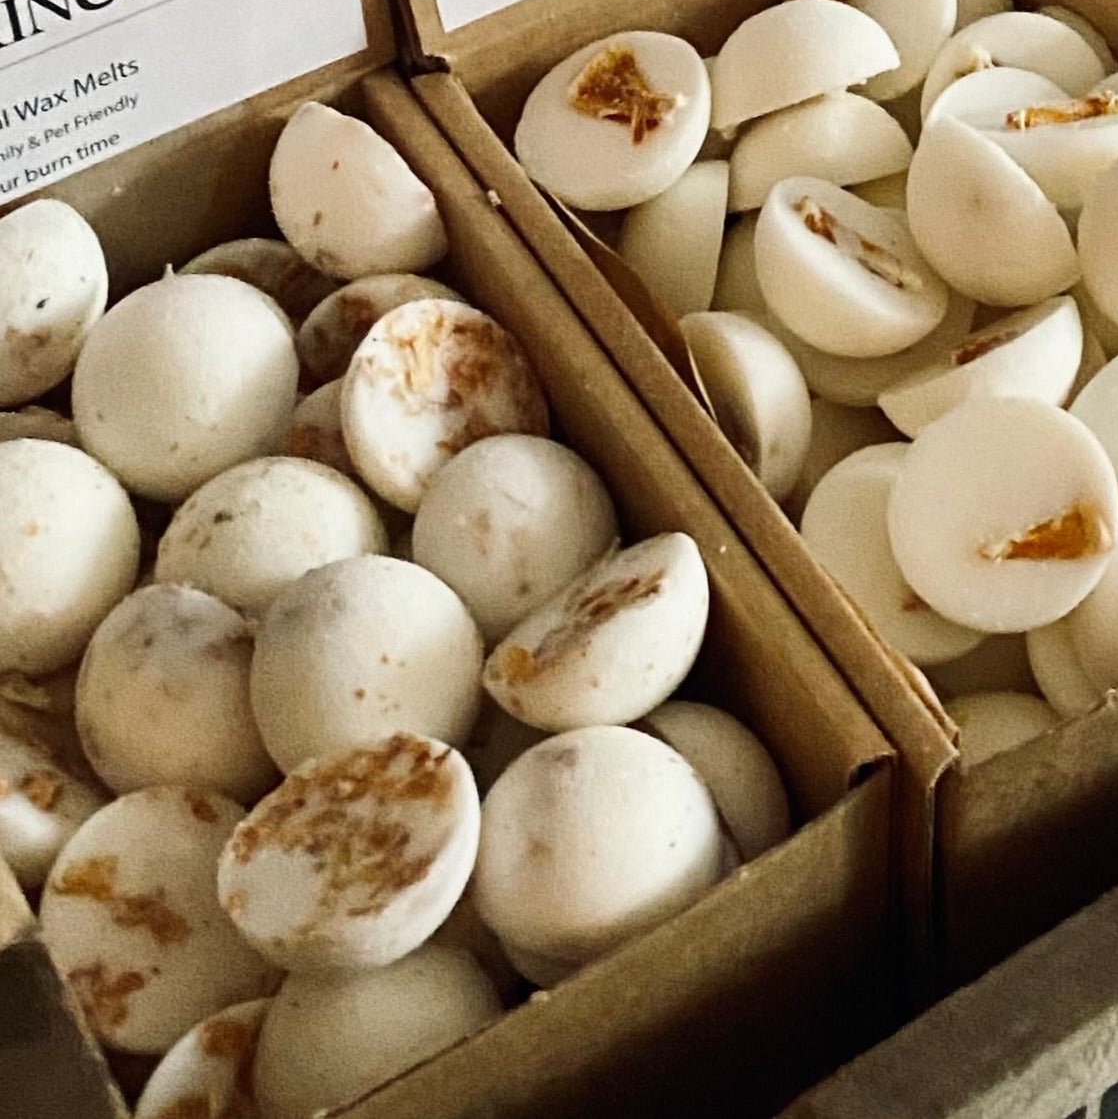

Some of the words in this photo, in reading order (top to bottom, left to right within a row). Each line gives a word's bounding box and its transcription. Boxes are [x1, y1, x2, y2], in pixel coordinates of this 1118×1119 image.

[14, 89, 68, 121] Wax
[73, 60, 139, 97] Melts
[27, 136, 41, 150] &
[44, 123, 70, 142] Pet
[74, 93, 139, 130] Friendly
[25, 155, 72, 183] burn
[76, 134, 120, 160] time
